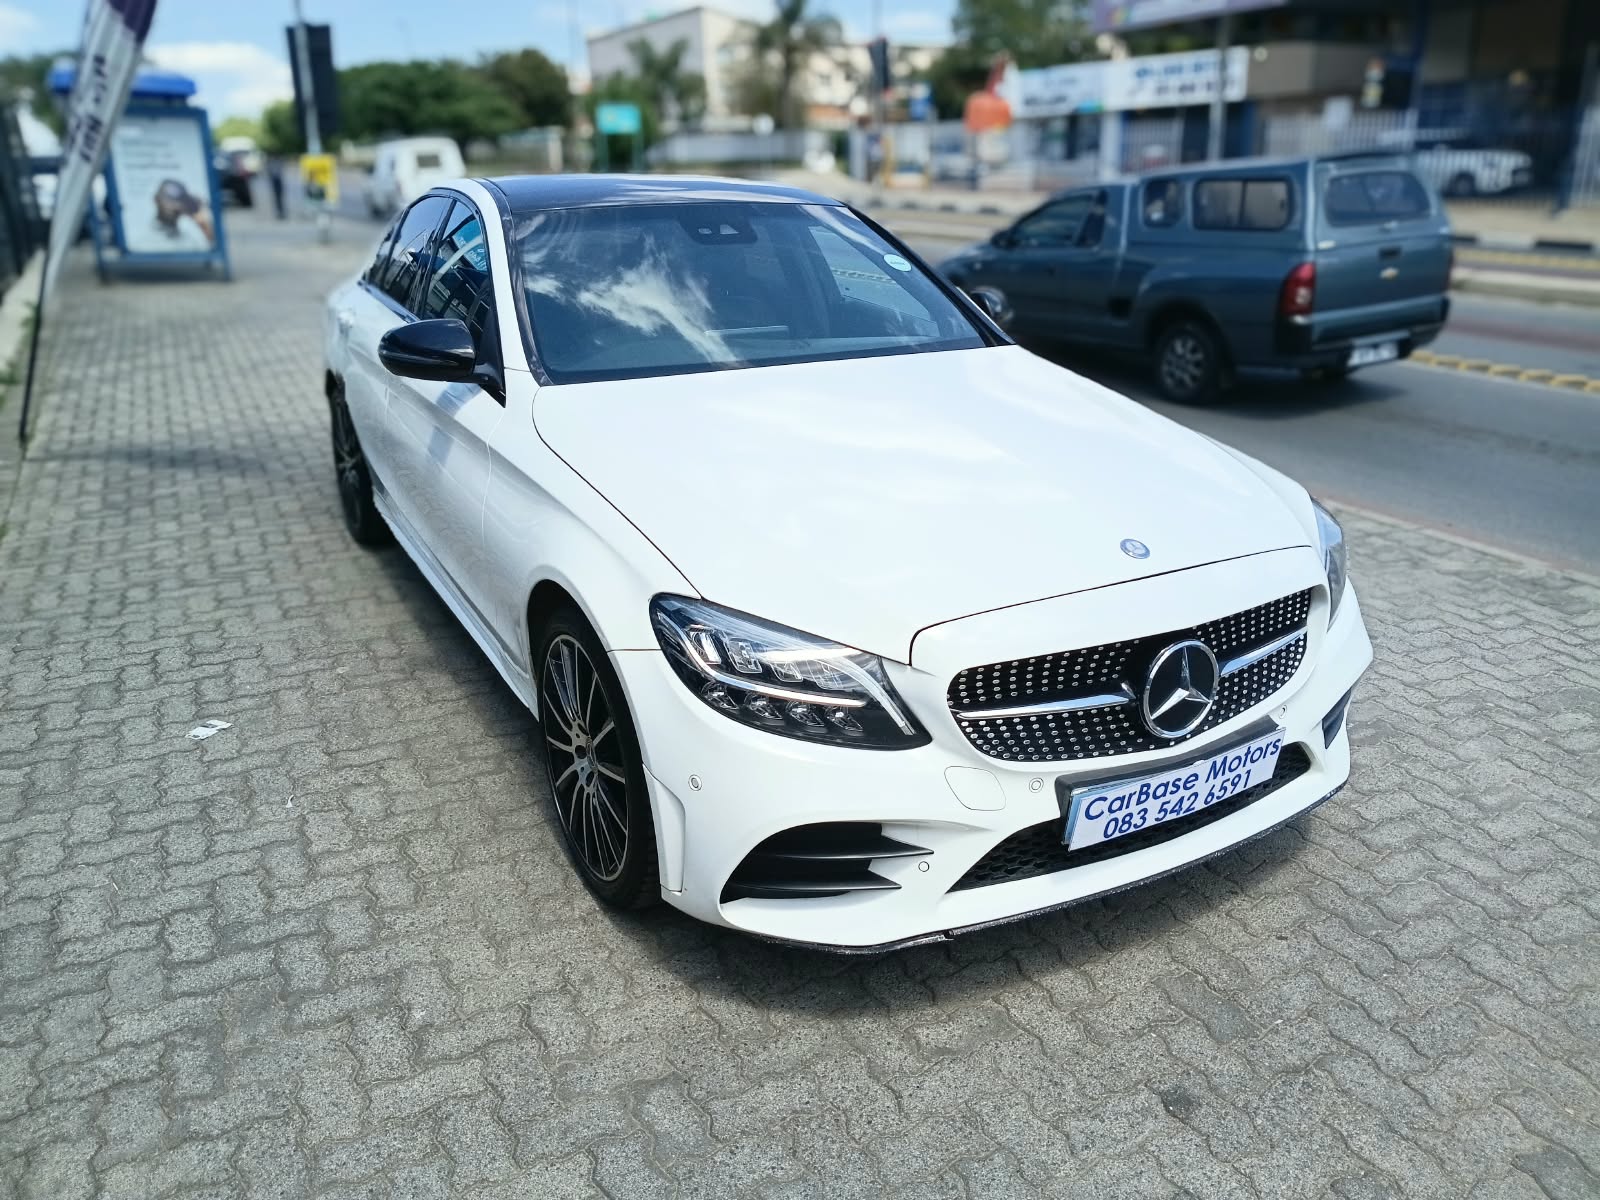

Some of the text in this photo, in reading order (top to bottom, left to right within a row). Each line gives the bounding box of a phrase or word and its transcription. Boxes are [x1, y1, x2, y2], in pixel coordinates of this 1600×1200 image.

[1084, 738, 1282, 821] CarBase Motors
[1103, 769, 1252, 839] 083 542 6591
